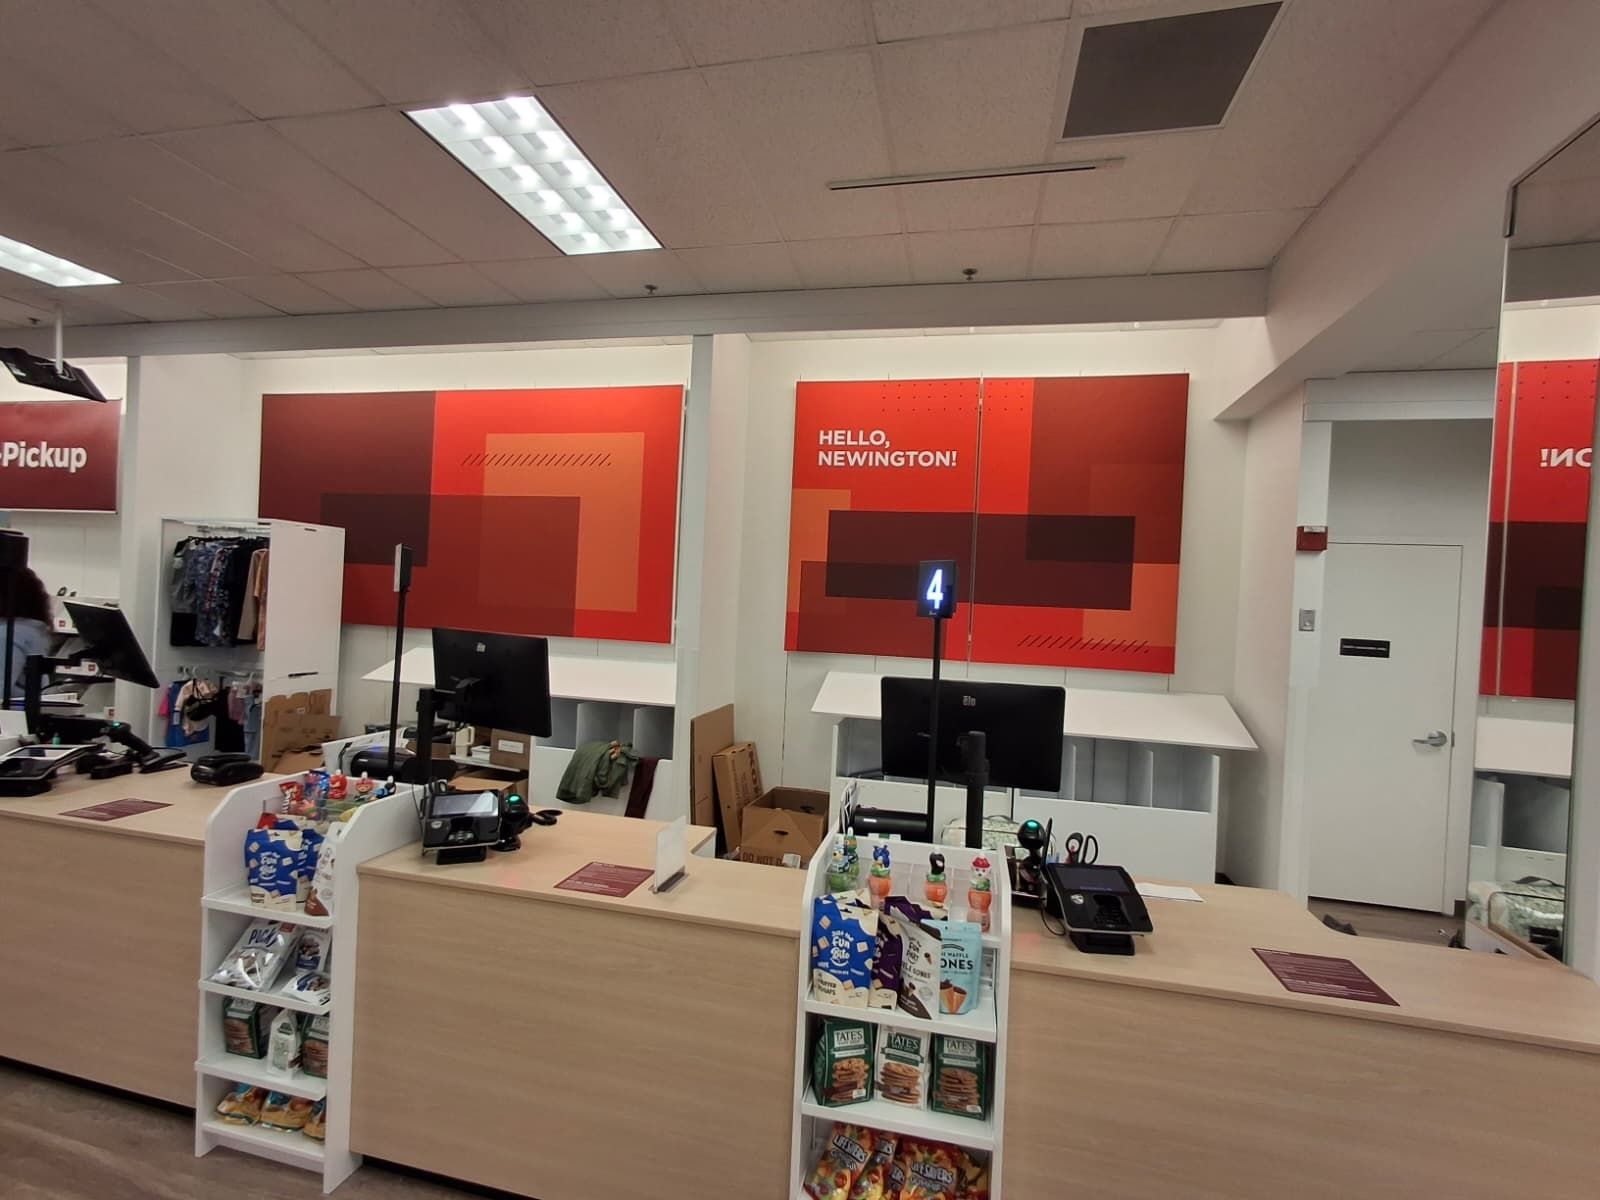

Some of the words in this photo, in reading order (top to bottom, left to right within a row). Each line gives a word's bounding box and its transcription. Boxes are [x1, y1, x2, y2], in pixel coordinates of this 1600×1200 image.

[818, 429, 890, 448] HELLO,
[0, 441, 88, 473] Pickup
[818, 450, 957, 467] NEWINGTON!
[926, 568, 944, 609] 4
[940, 958, 973, 970] ONES
